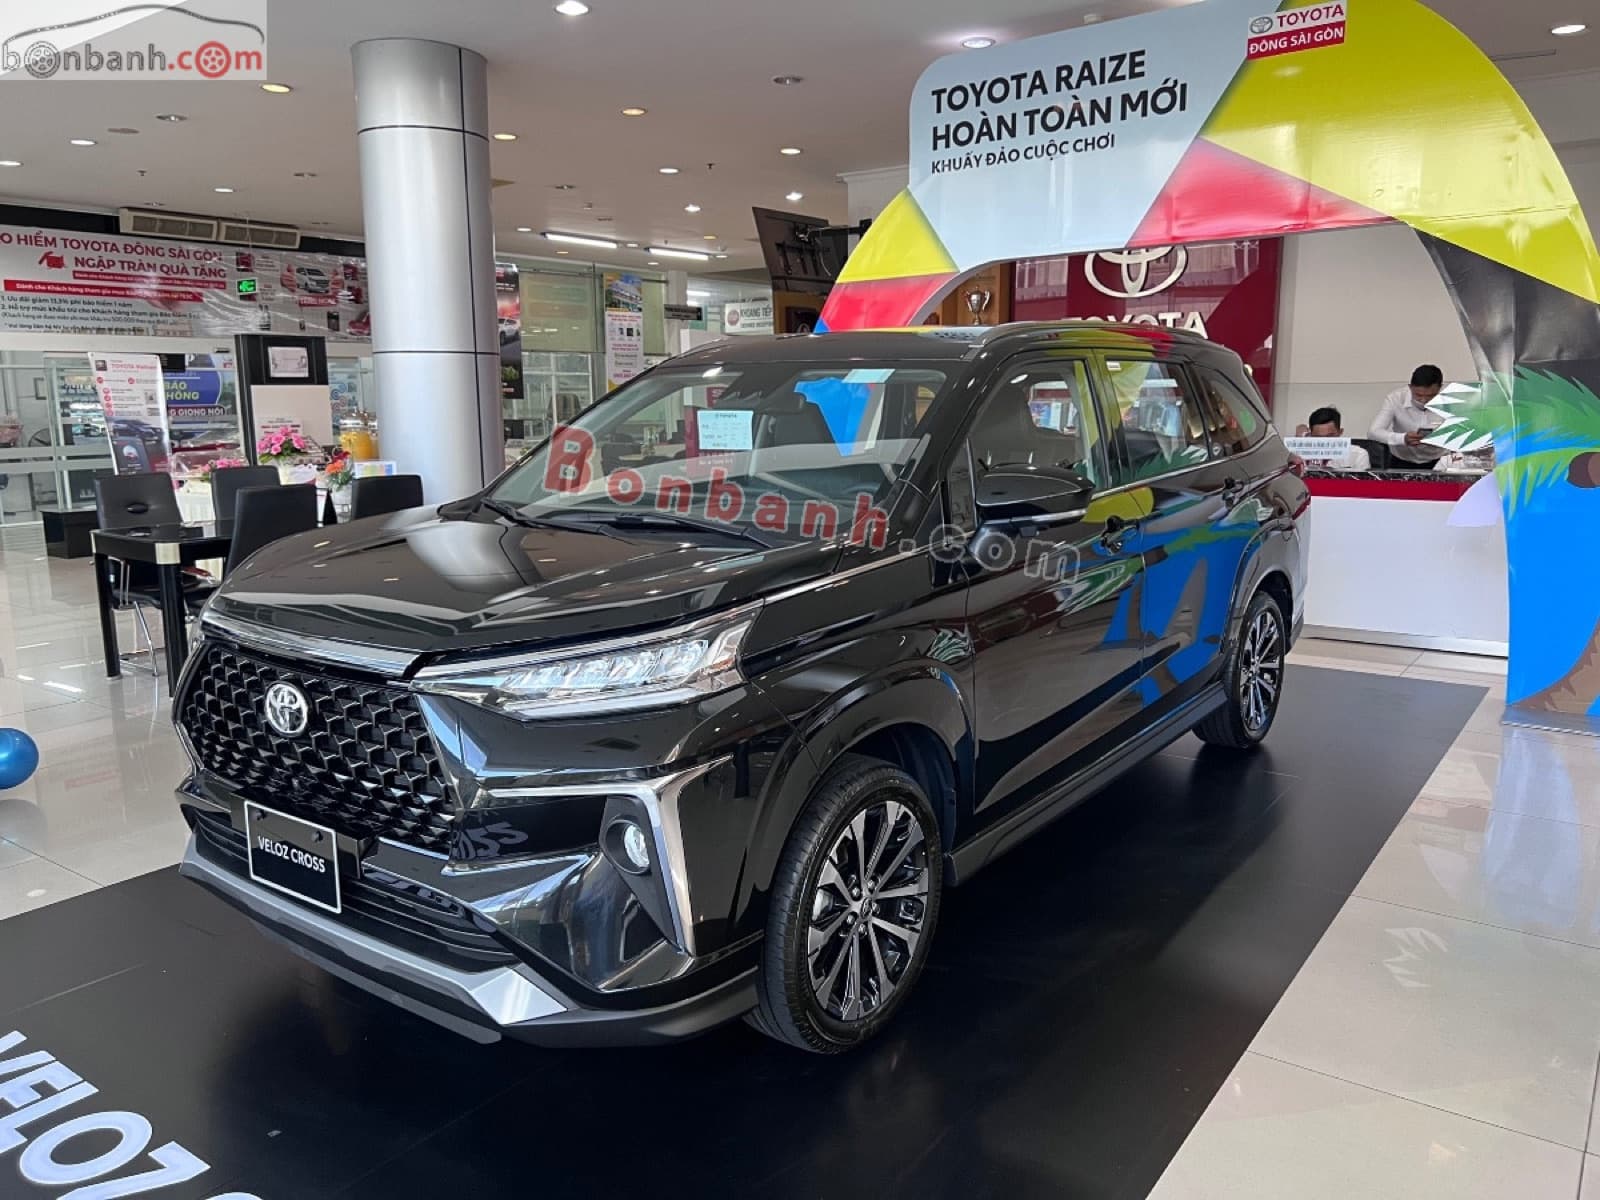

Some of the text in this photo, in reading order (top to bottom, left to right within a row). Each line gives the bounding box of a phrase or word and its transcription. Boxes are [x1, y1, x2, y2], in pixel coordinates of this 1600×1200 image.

[1277, 4, 1344, 27] TOYOTA
[1249, 26, 1344, 54] ĐÔNG SÀI GÒN
[931, 49, 1146, 114] TOYOTA RAIZE
[932, 77, 1188, 150] HOÀN TOÀN MỚI
[931, 133, 1115, 174] KHUẤY ĐẢO CUỘC CHƠI
[0, 230, 223, 261] O HIỂM TOYOTA ĐÔNG SÀI GÒN
[74, 255, 226, 279] NGẬP TRÀN QUÀ TẶNG
[258, 835, 326, 873] VELOZ CROSS
